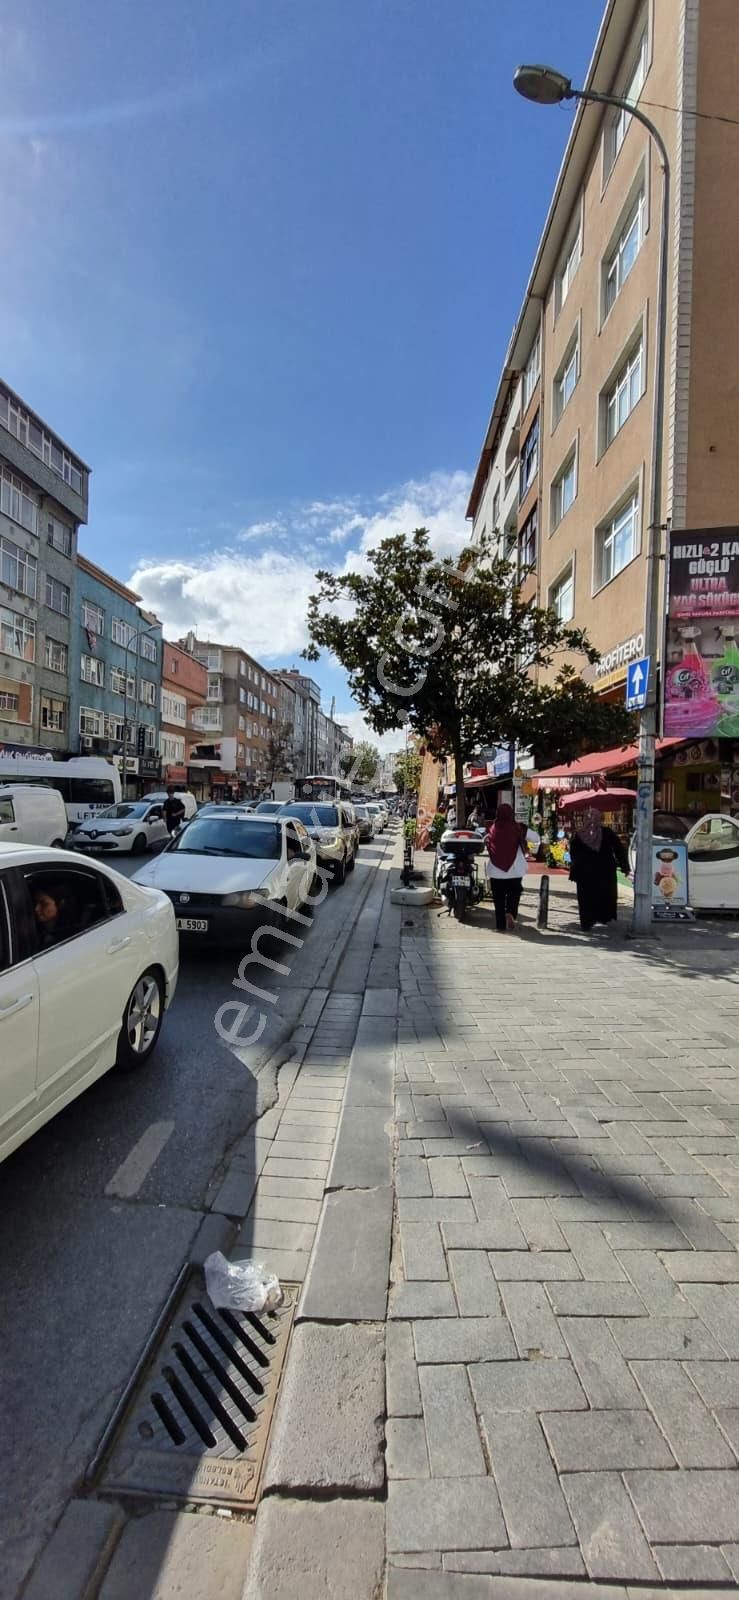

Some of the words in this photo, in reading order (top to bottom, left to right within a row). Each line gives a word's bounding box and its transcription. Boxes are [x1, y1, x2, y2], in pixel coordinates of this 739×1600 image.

[673, 544, 703, 559] HIZLI
[710, 543, 720, 557] 2
[690, 576, 727, 592] ULTRA
[186, 919, 207, 930] 5903
